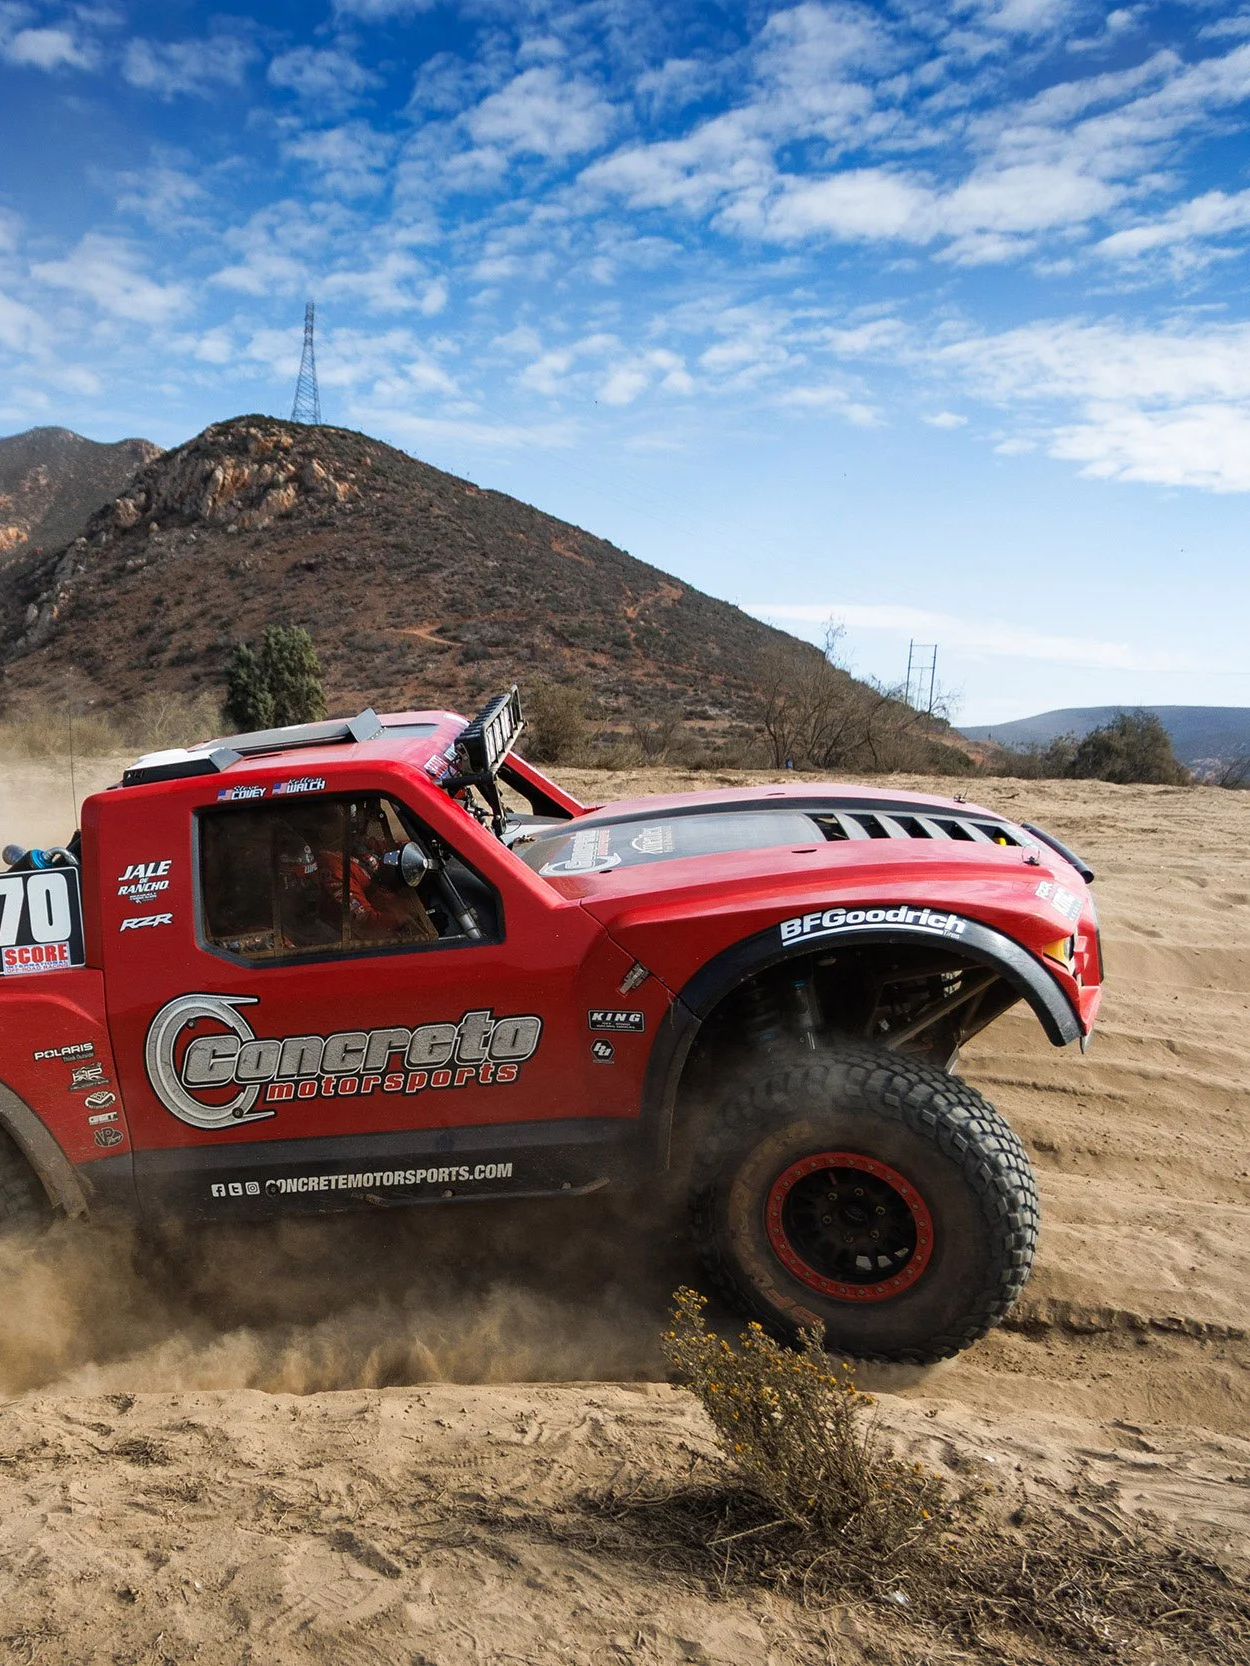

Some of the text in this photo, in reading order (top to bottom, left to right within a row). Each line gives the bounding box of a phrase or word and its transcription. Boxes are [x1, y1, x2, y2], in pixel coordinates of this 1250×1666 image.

[231, 787, 267, 800] COVEY
[286, 780, 326, 794] WALCH
[118, 860, 172, 881] JALE
[117, 880, 170, 896] RANCHO
[119, 912, 174, 932] RZR
[779, 905, 966, 941] BFGoodrich
[4, 943, 69, 966] SCORE
[592, 1012, 641, 1022] KING
[34, 1042, 94, 1060] POLARIS
[265, 1062, 518, 1102] motorsports
